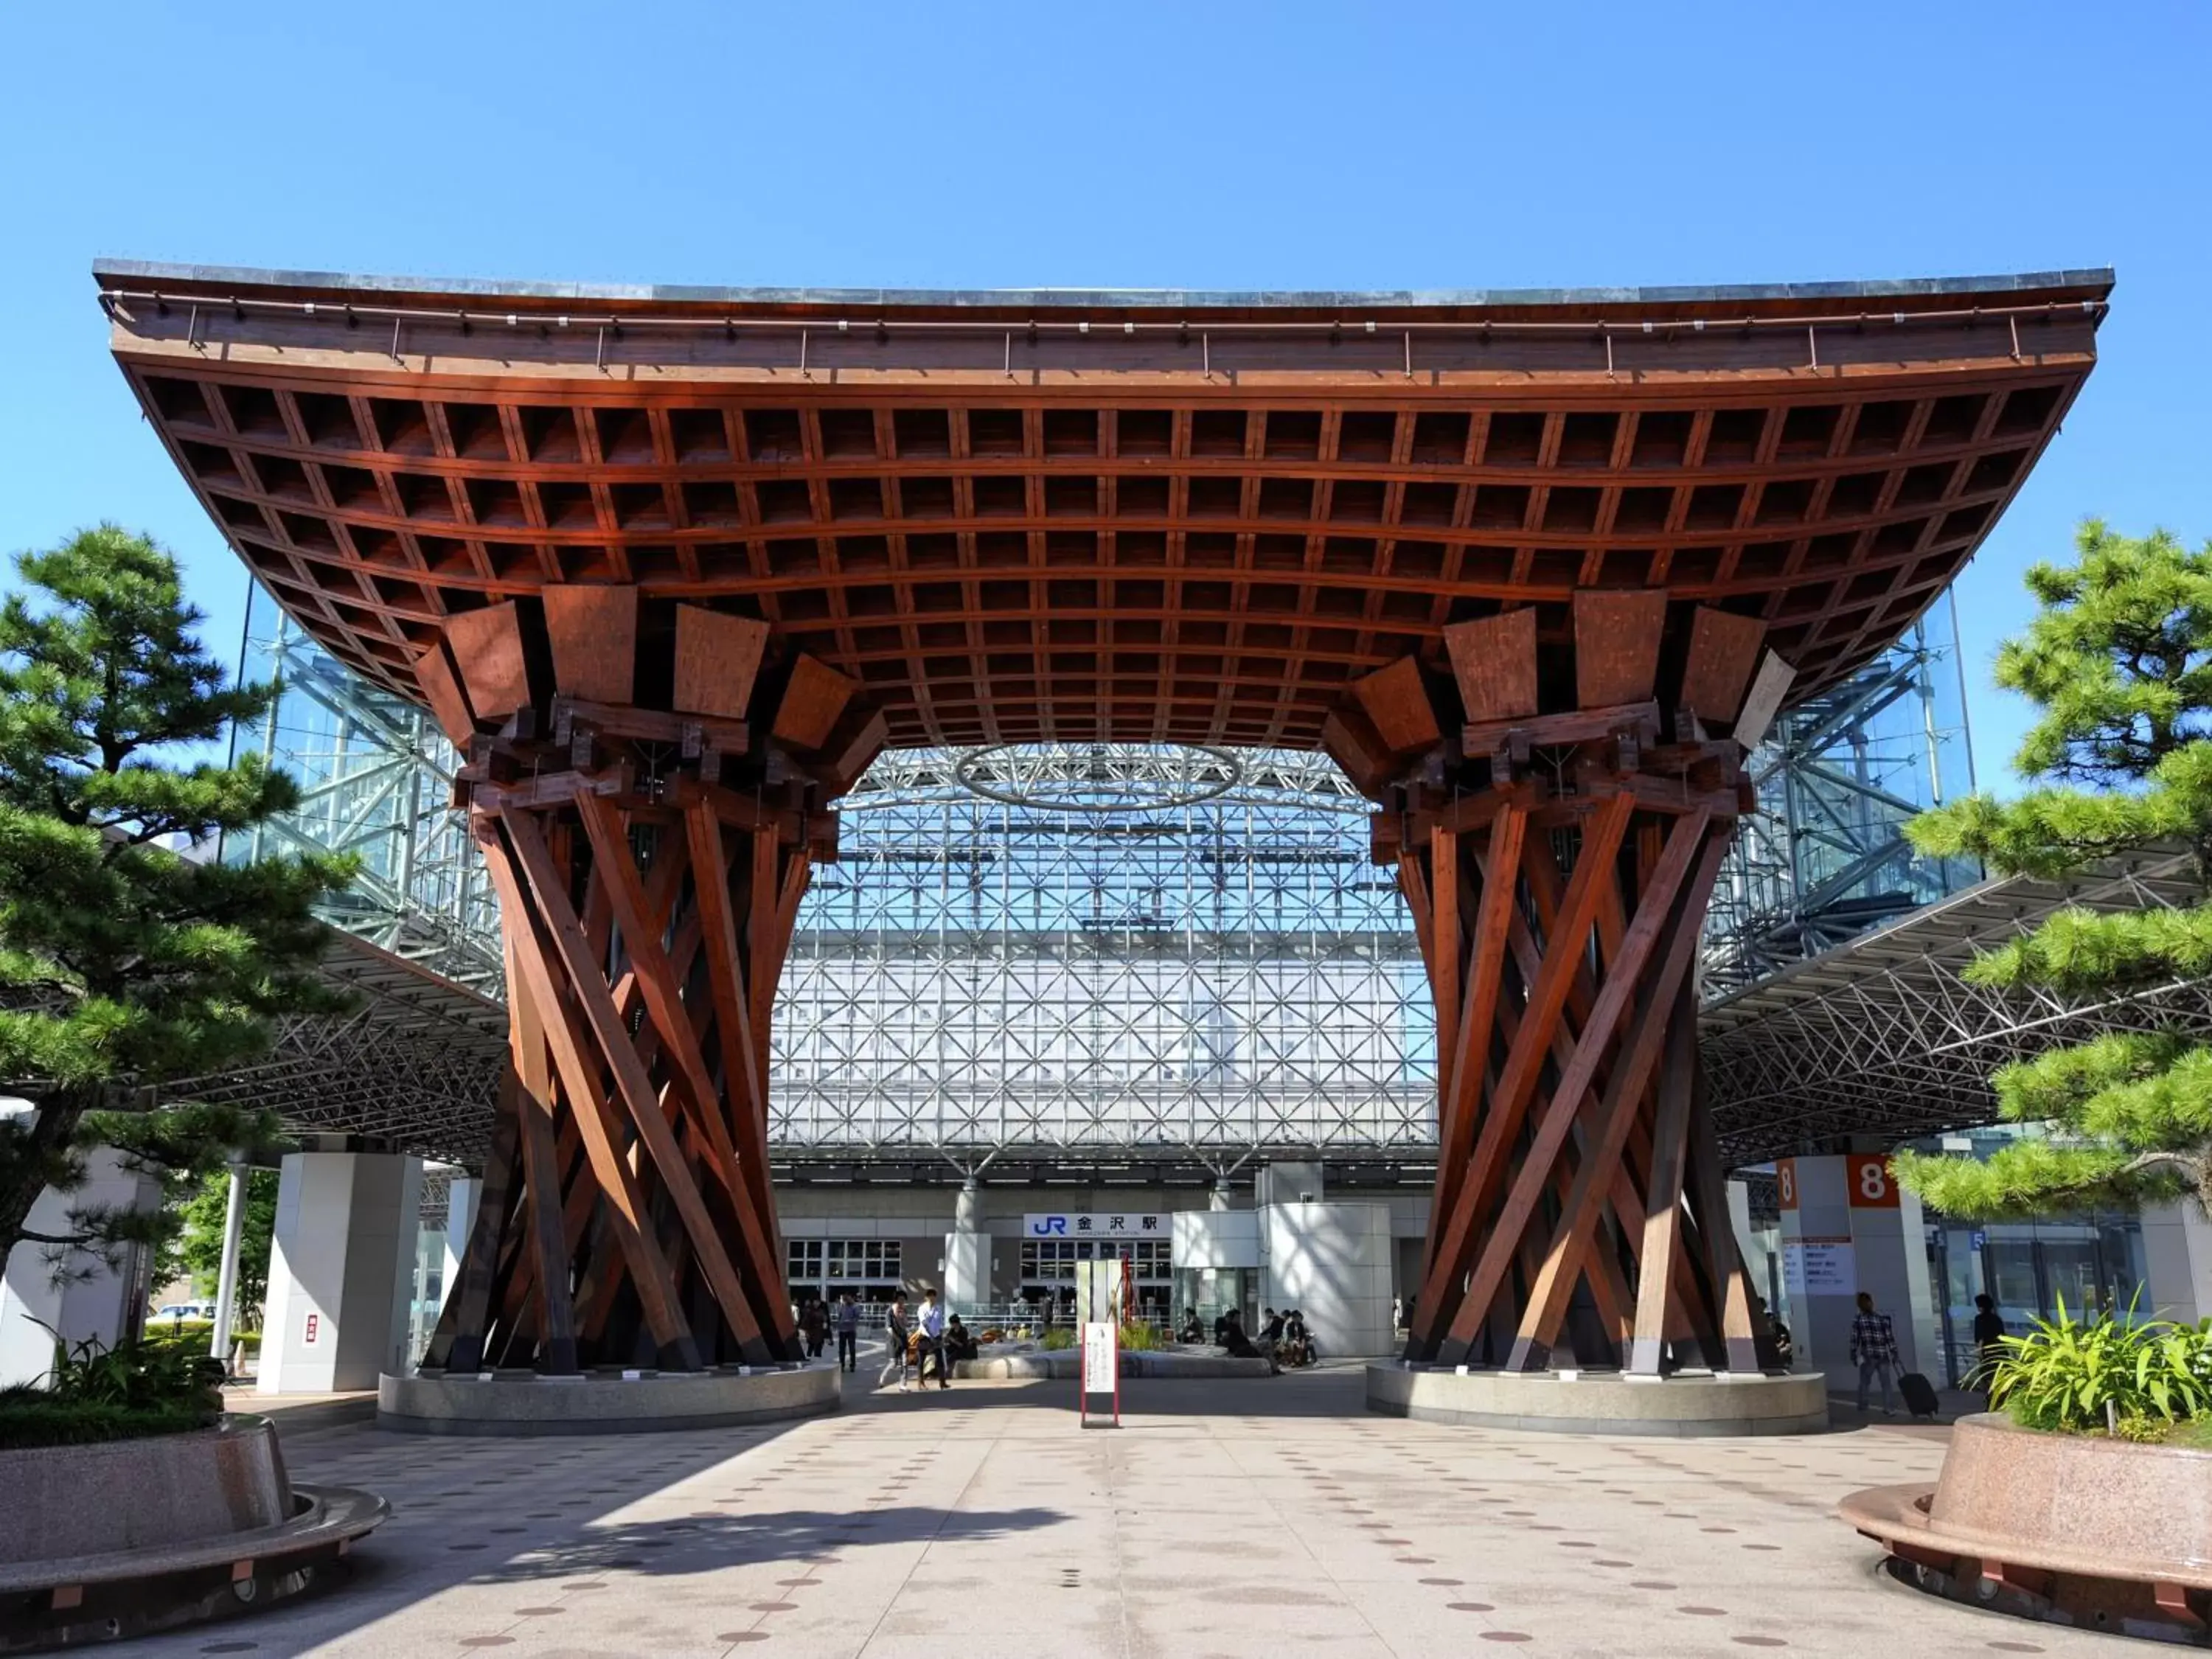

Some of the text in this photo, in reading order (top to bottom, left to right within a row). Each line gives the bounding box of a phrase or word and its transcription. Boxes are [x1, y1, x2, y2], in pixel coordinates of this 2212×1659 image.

[1782, 1167, 1792, 1202] 8
[1860, 1164, 1885, 1199] 8
[1034, 1216, 1157, 1235] JR 金沢駅
[1974, 1233, 1984, 1249] 5
